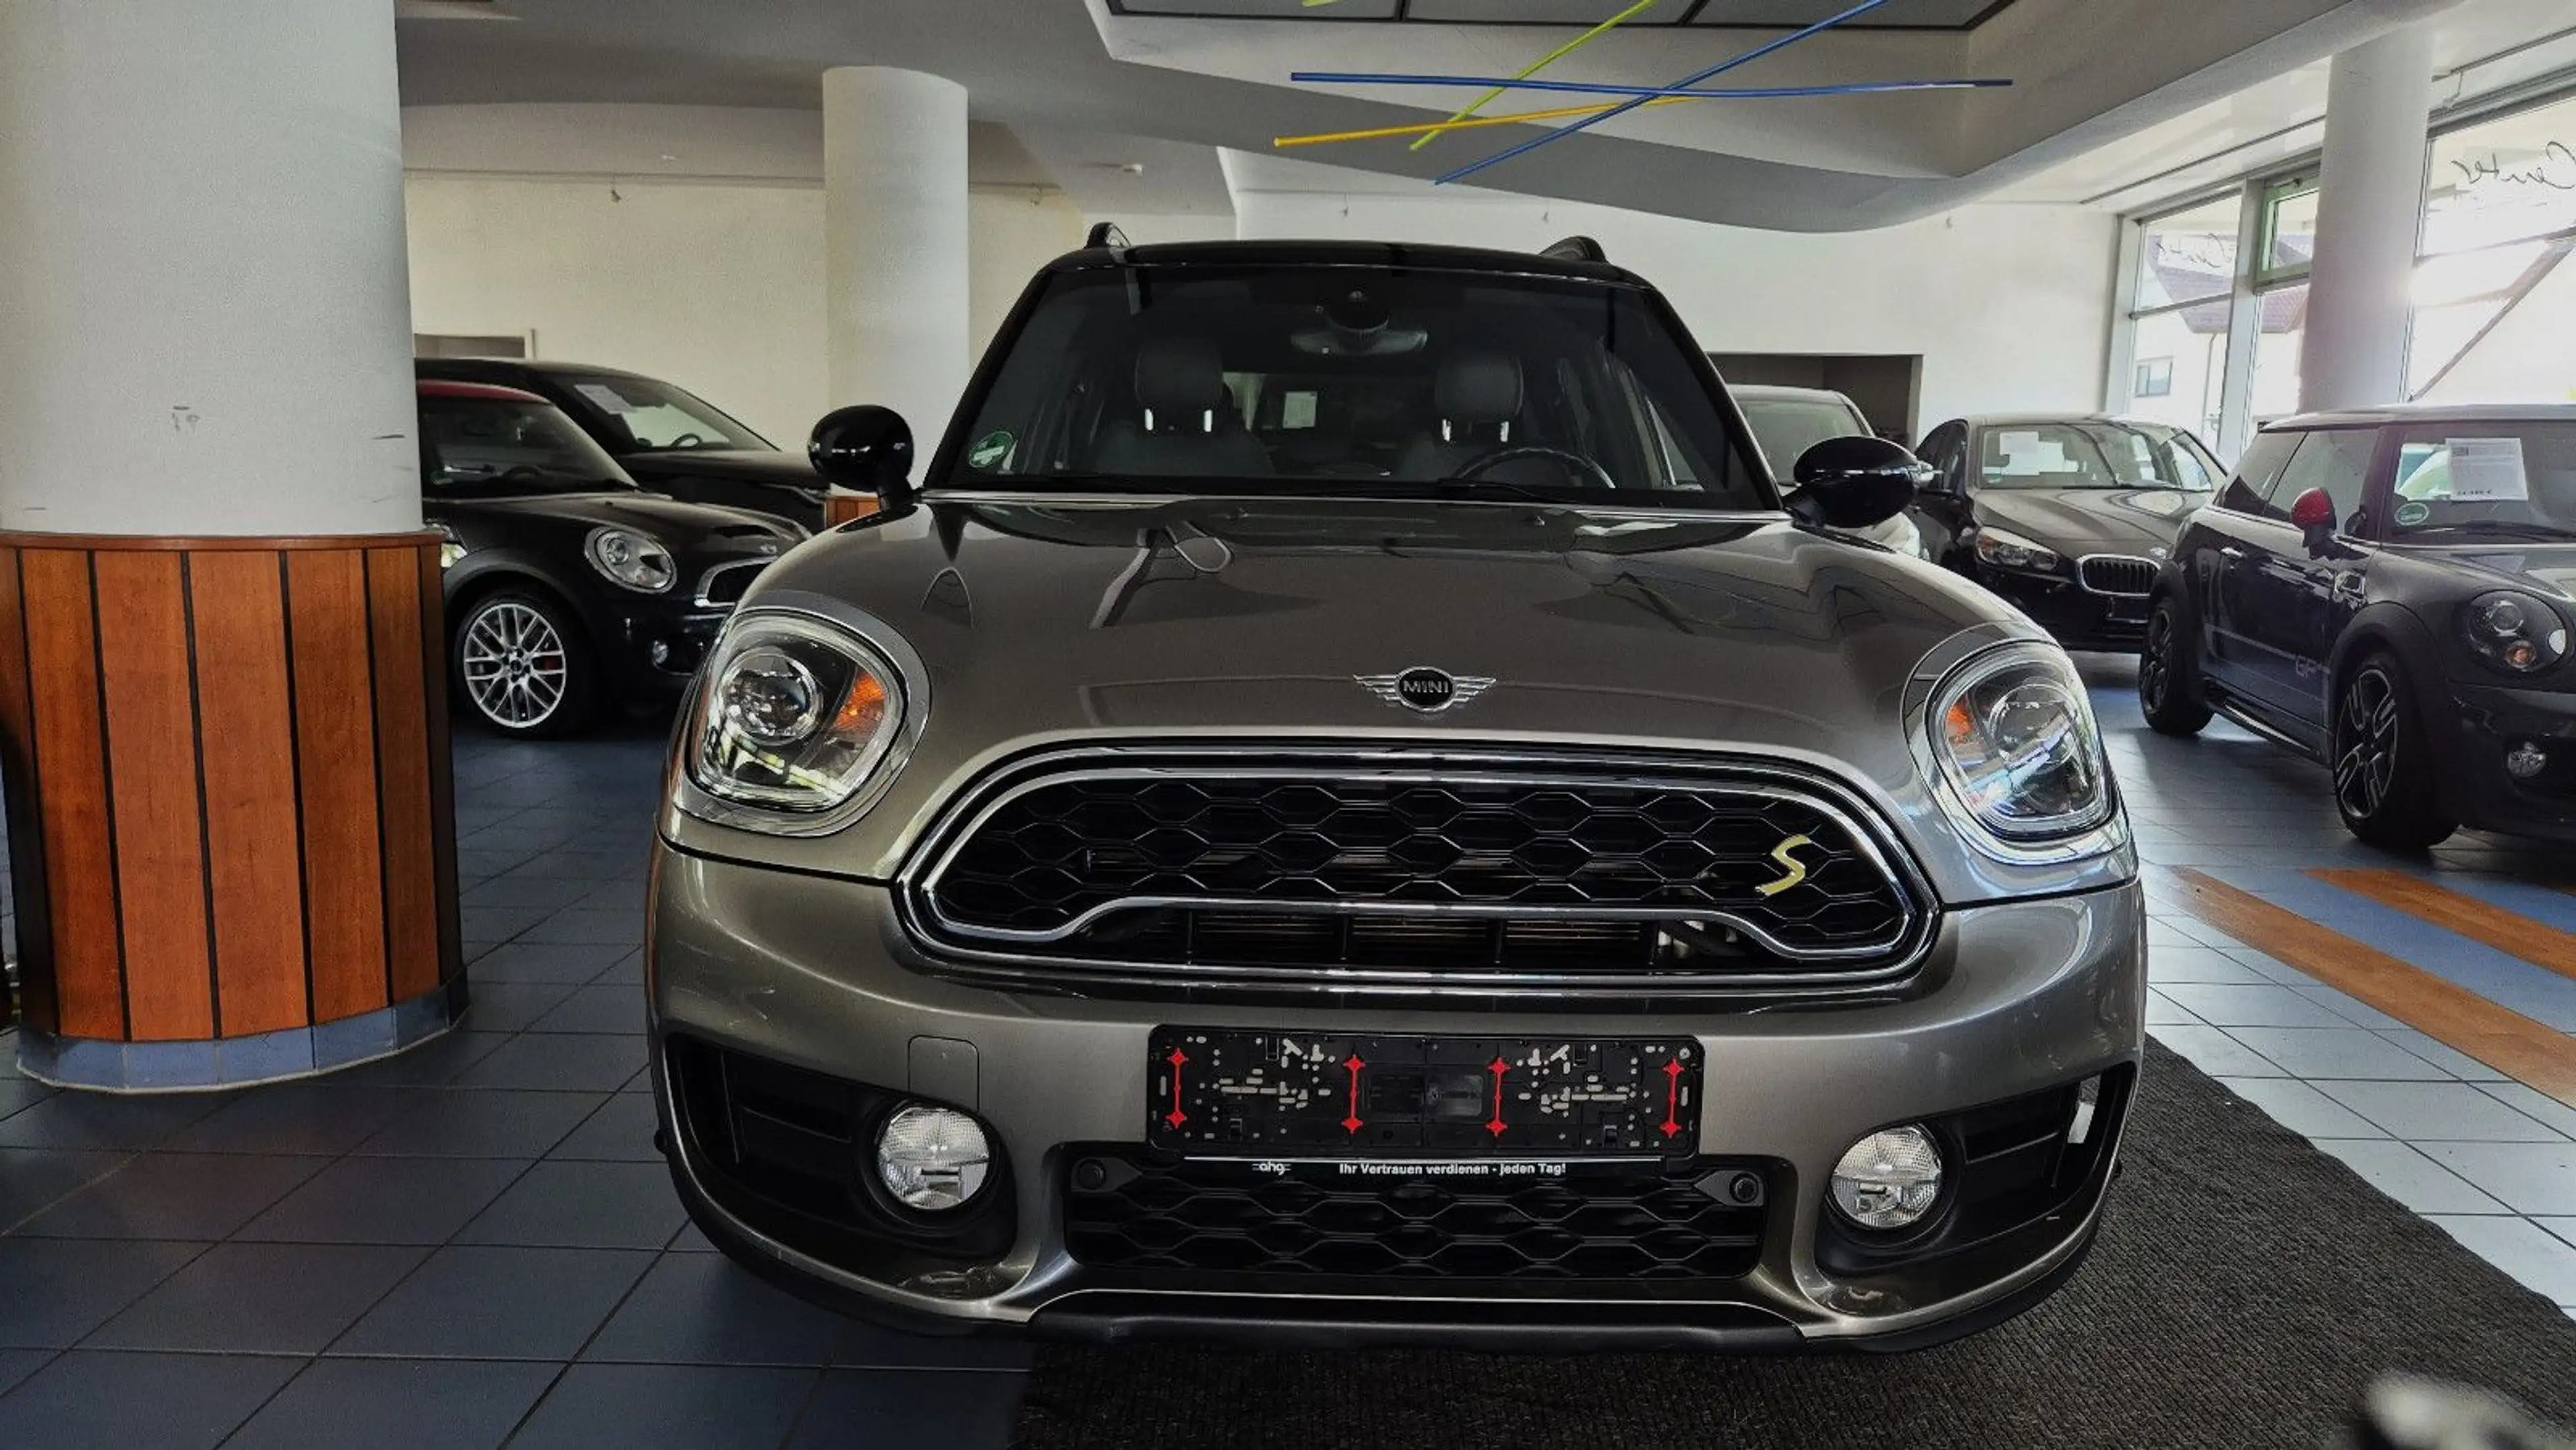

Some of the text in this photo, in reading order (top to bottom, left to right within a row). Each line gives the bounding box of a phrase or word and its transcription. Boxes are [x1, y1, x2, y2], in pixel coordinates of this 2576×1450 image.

[1403, 680, 1449, 693] MINI
[1755, 834, 1812, 896] S
[1258, 1162, 1285, 1176] ahg
[1339, 1164, 1358, 1174] Ihr
[1360, 1164, 1423, 1174] Vertrauen
[1426, 1164, 1489, 1174] verdienen
[1538, 1164, 1566, 1176] Tag!
